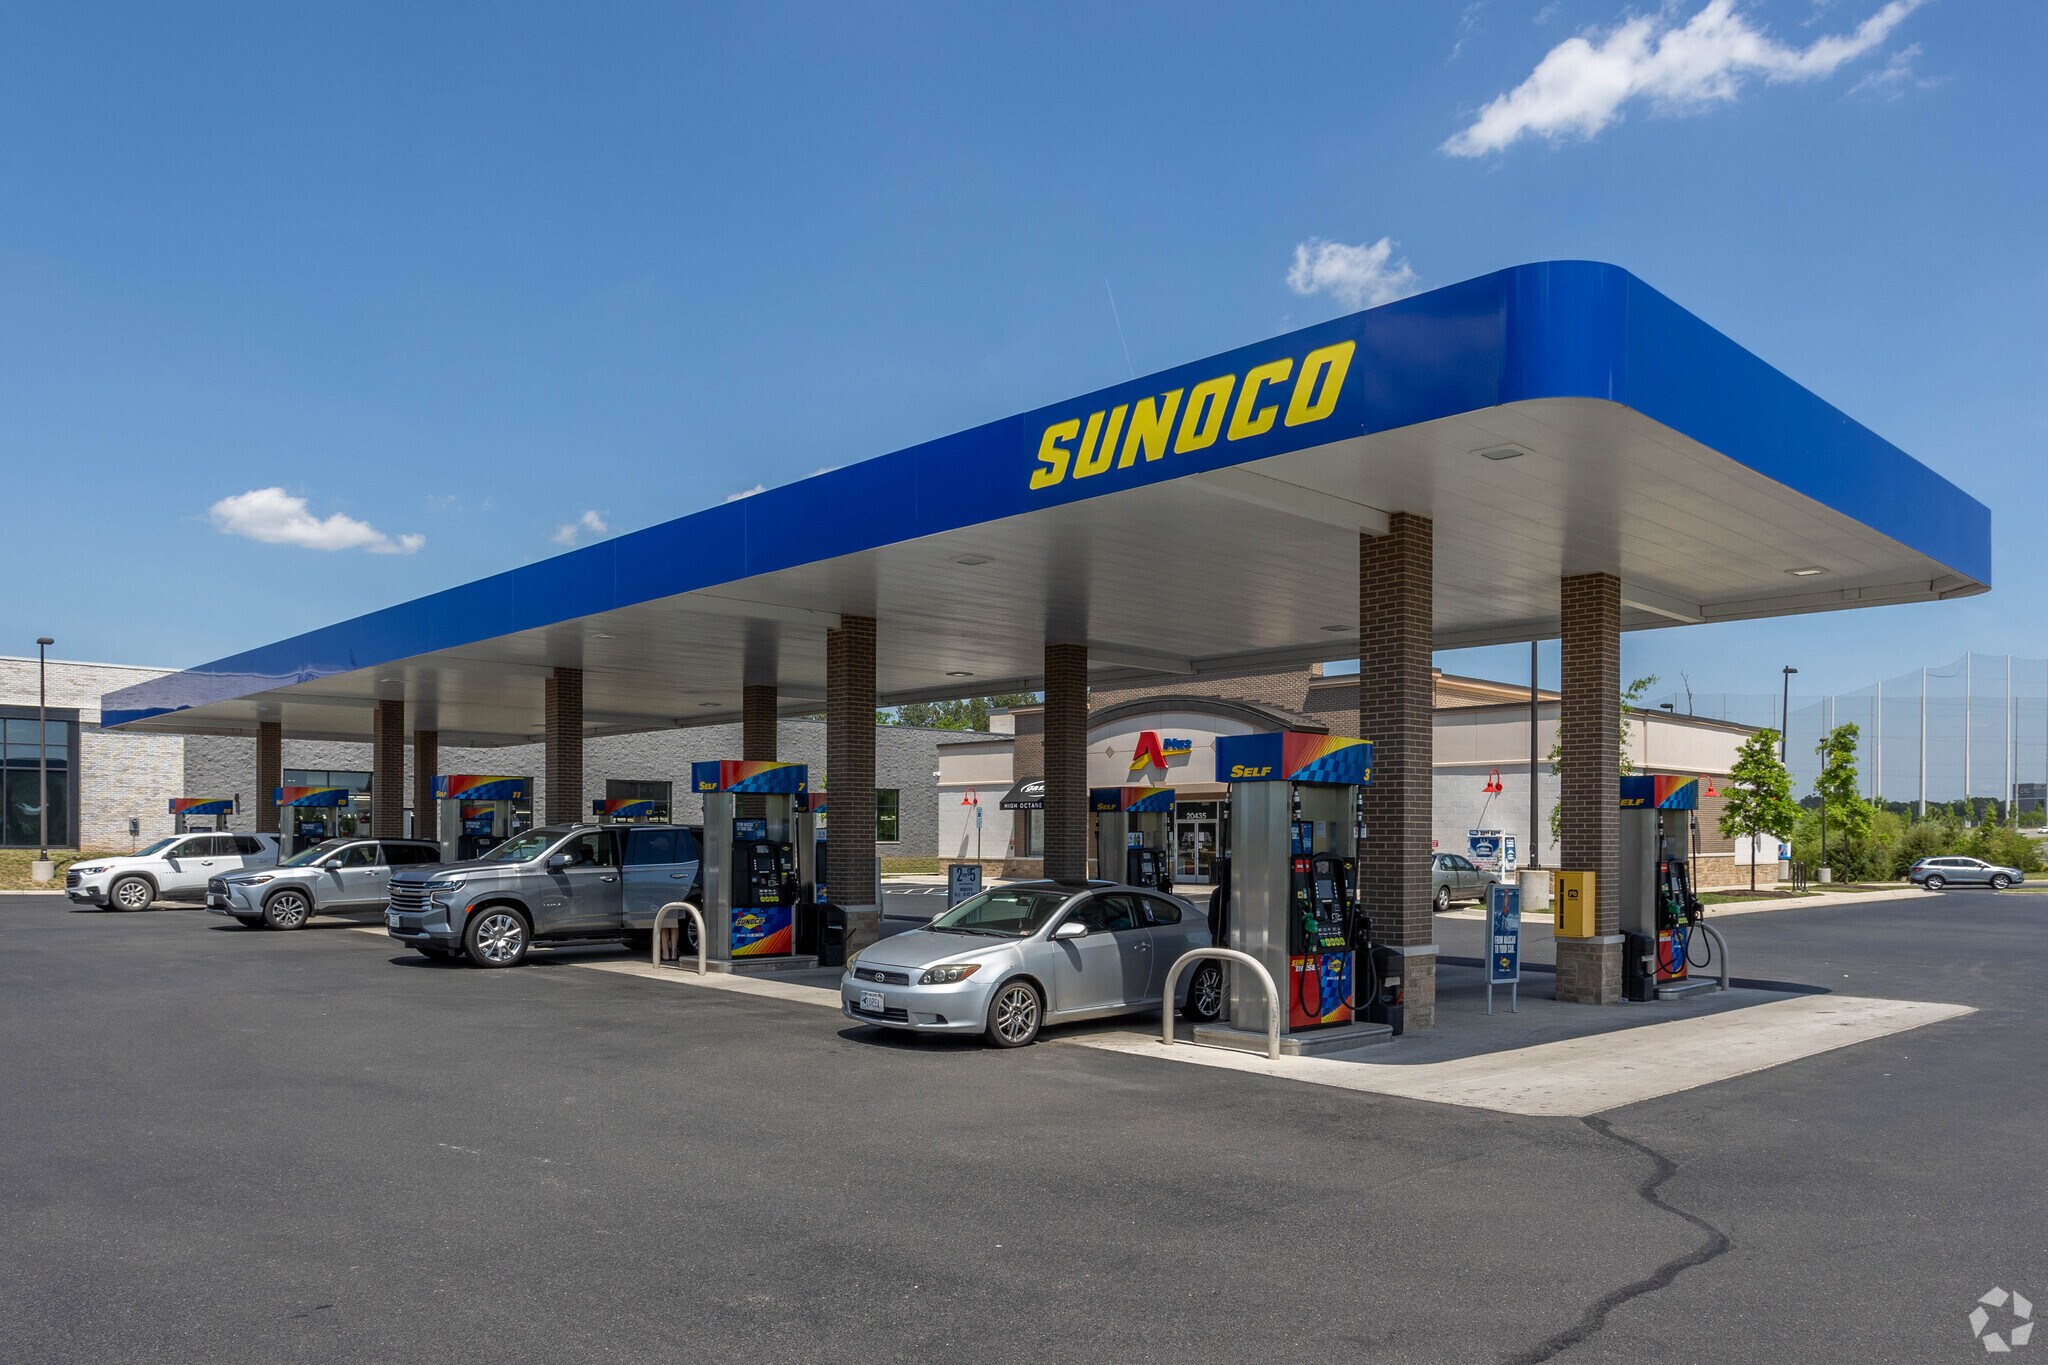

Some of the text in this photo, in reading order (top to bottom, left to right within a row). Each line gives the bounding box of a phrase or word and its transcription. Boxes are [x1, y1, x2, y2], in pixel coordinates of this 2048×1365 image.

[1029, 340, 1356, 490] SUNOCO
[1231, 765, 1371, 781] SELF 3
[699, 781, 805, 791] SELF 7
[1619, 798, 1645, 806] ELF
[957, 868, 962, 882] 2
[1292, 958, 1314, 966] SUNCO
